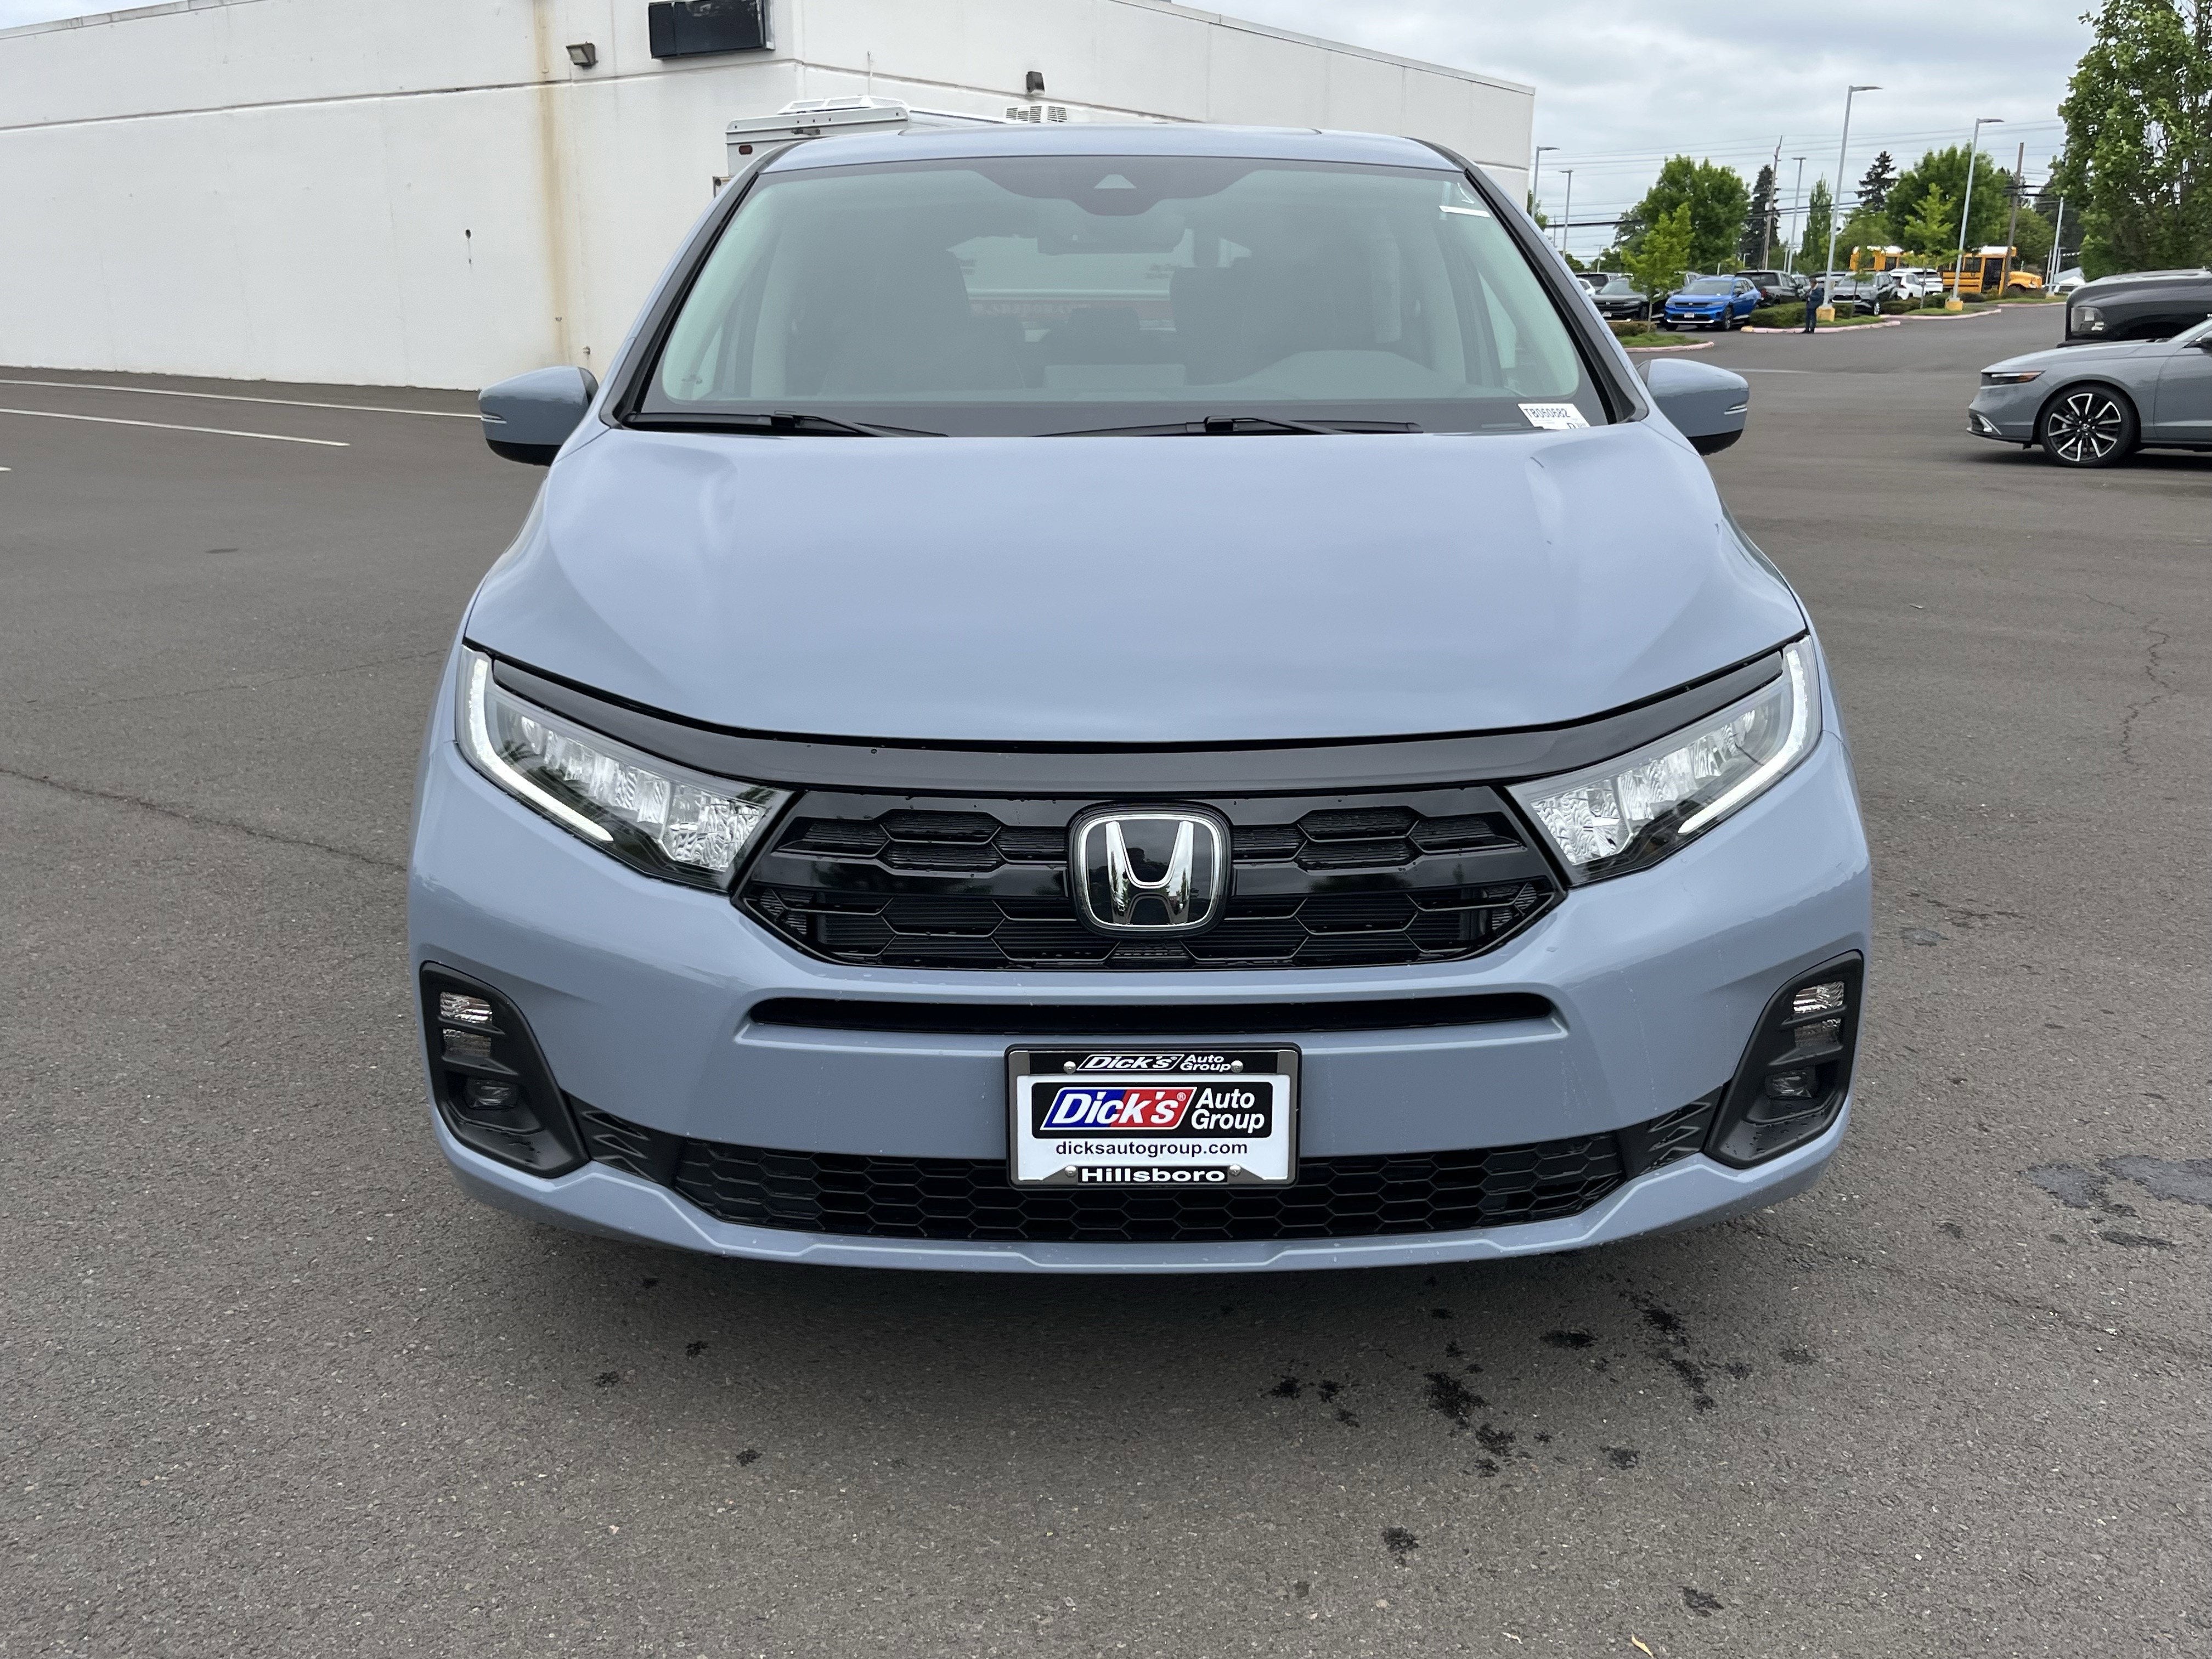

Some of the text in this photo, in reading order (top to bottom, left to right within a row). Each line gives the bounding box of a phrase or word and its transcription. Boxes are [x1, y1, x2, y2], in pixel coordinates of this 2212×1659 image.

[1184, 1054, 1224, 1063] Auto
[1180, 1062, 1231, 1072] Group
[1195, 1088, 1255, 1109] Auto
[1191, 1109, 1265, 1133] Group
[1056, 1141, 1248, 1158] dicksautogroup.com
[1082, 1168, 1226, 1182] Hillsboro
